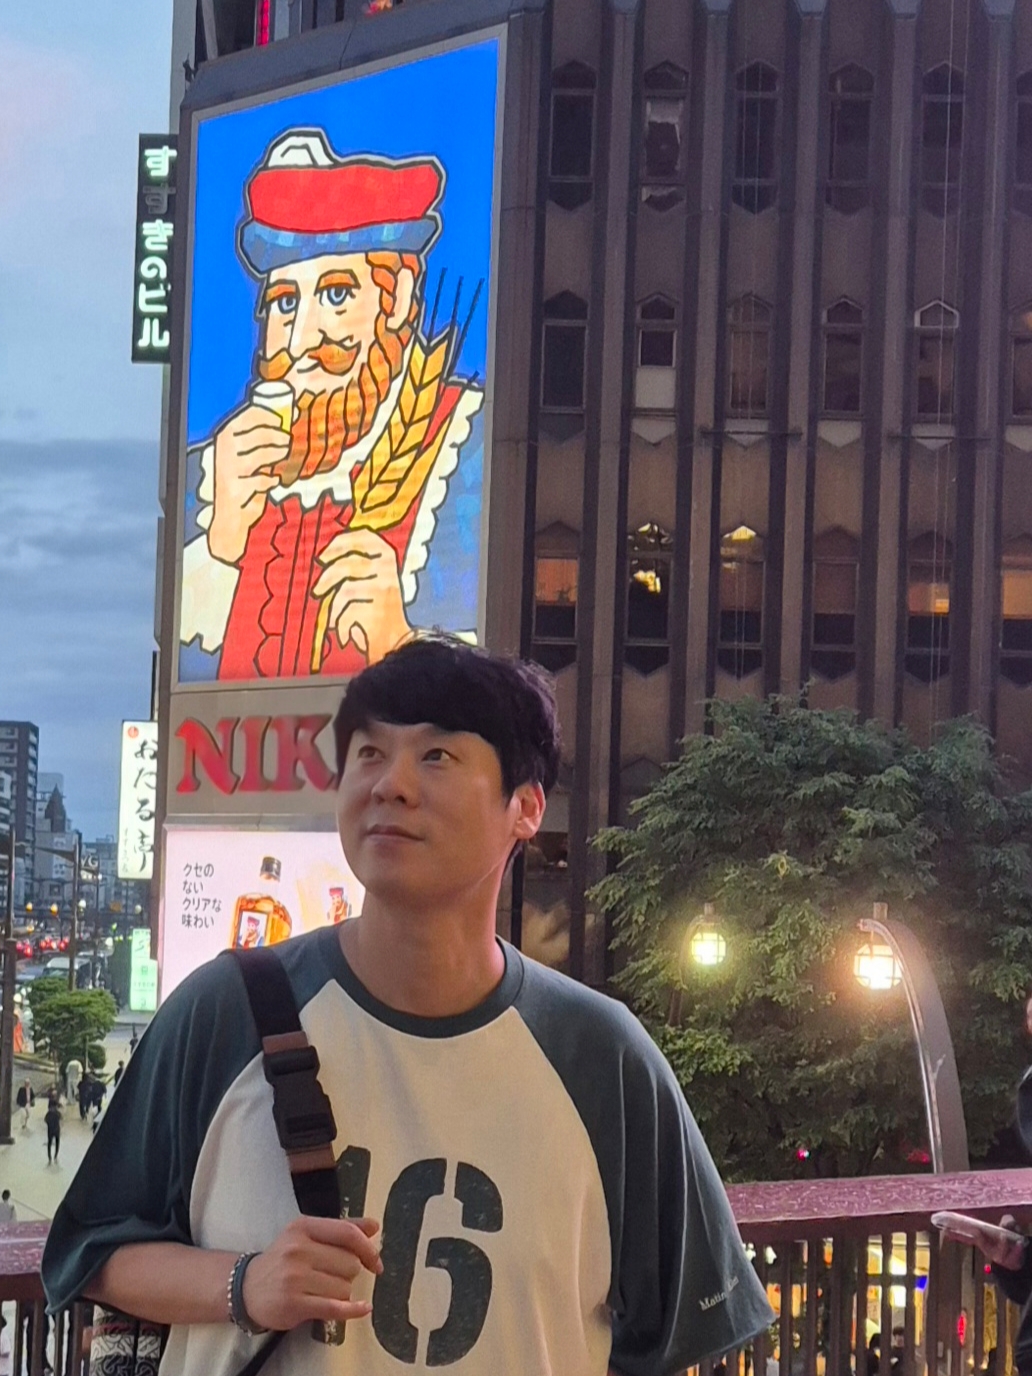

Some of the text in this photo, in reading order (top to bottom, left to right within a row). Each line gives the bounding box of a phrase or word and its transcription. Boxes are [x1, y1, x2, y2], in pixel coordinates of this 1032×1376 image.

[138, 145, 178, 348] すすきのビル
[175, 713, 339, 795] NIK
[183, 862, 215, 878] クセの
[182, 880, 204, 894] ない
[182, 897, 222, 913] クリアな
[181, 914, 215, 929] 味わい
